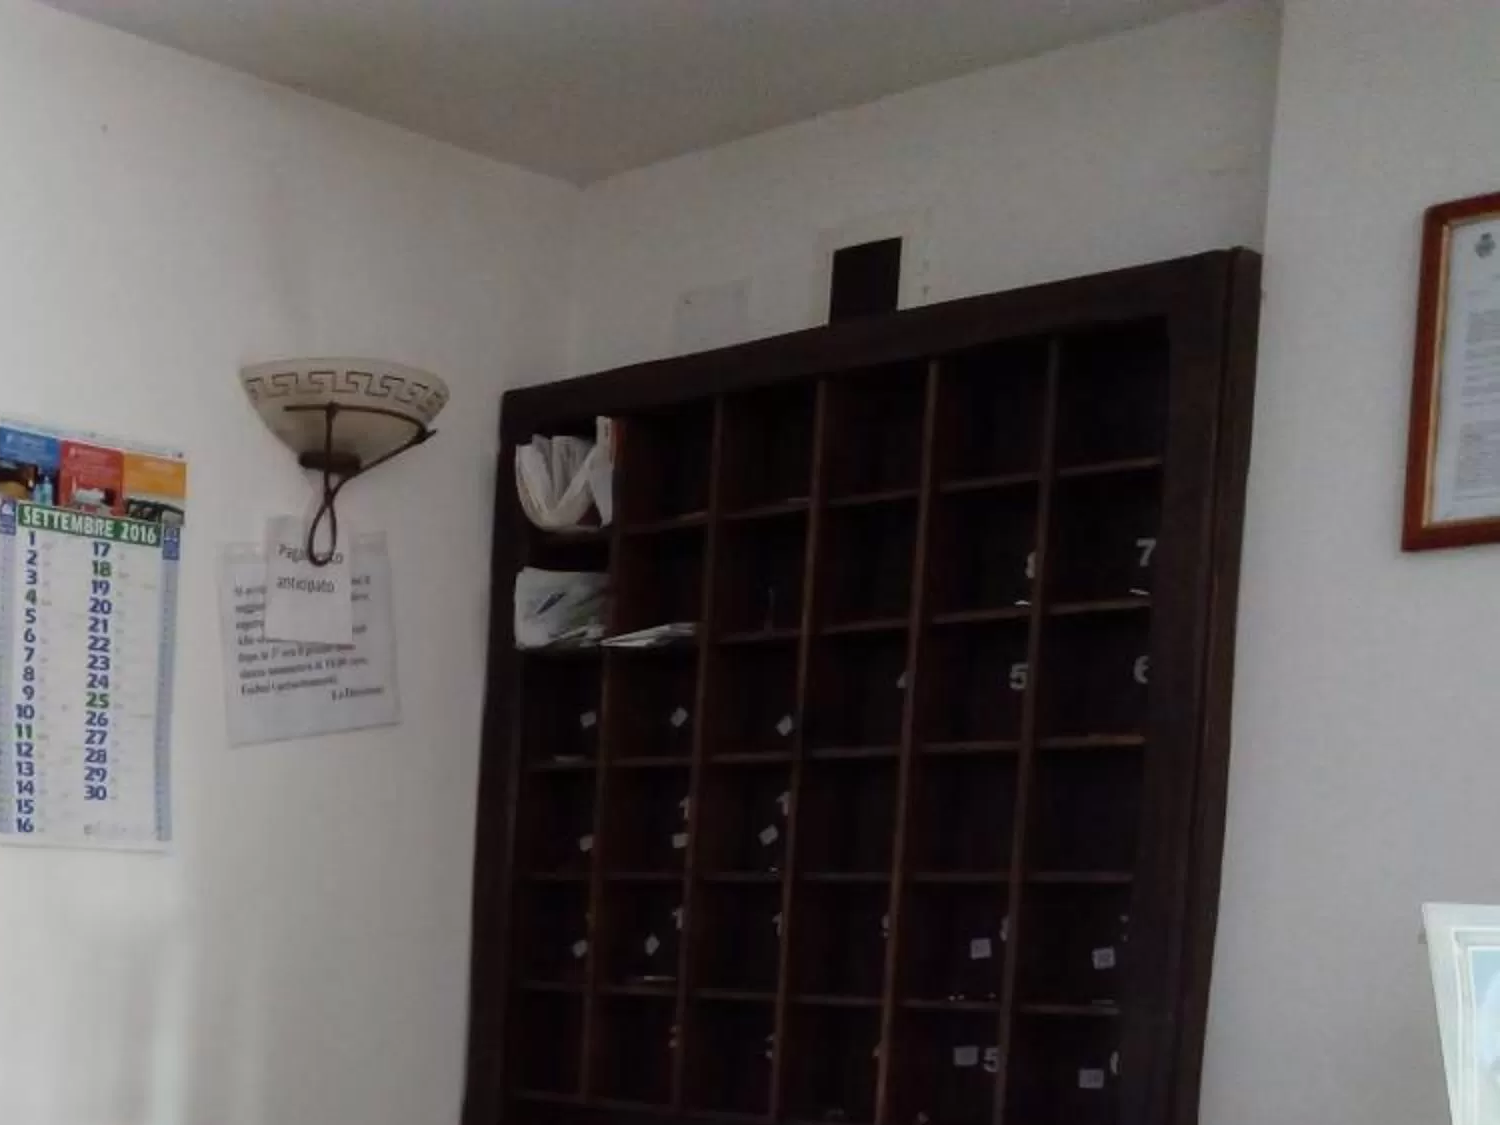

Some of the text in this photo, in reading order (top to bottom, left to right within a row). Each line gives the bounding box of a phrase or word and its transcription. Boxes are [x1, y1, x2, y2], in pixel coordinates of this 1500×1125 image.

[22, 509, 113, 538] SETTEMBRE
[120, 523, 158, 545] 2016
[28, 531, 35, 546] 1
[92, 541, 111, 557] 17
[1135, 536, 1157, 567] 7
[26, 549, 37, 566] 2
[91, 560, 112, 577] 18
[25, 569, 37, 585] 3
[91, 580, 110, 596] 19
[88, 597, 112, 615] 20
[24, 608, 37, 624] 5
[88, 616, 109, 633] 21
[23, 628, 36, 643] 6
[87, 635, 111, 652] 22
[23, 646, 35, 662] 7
[87, 654, 110, 671] 23
[22, 665, 35, 682] 8
[87, 673, 109, 689] 24
[22, 685, 35, 701] 9
[85, 692, 109, 709] 25
[16, 703, 35, 720] 10
[84, 711, 109, 727] 26
[15, 724, 33, 739] 11
[84, 729, 108, 745] 27
[16, 742, 34, 758] 12
[84, 748, 107, 763] 28
[16, 761, 35, 777] 13
[83, 766, 107, 782] 29
[16, 780, 35, 796] 14
[83, 785, 107, 801] 30
[16, 799, 35, 814] 15
[16, 818, 34, 833] 16
